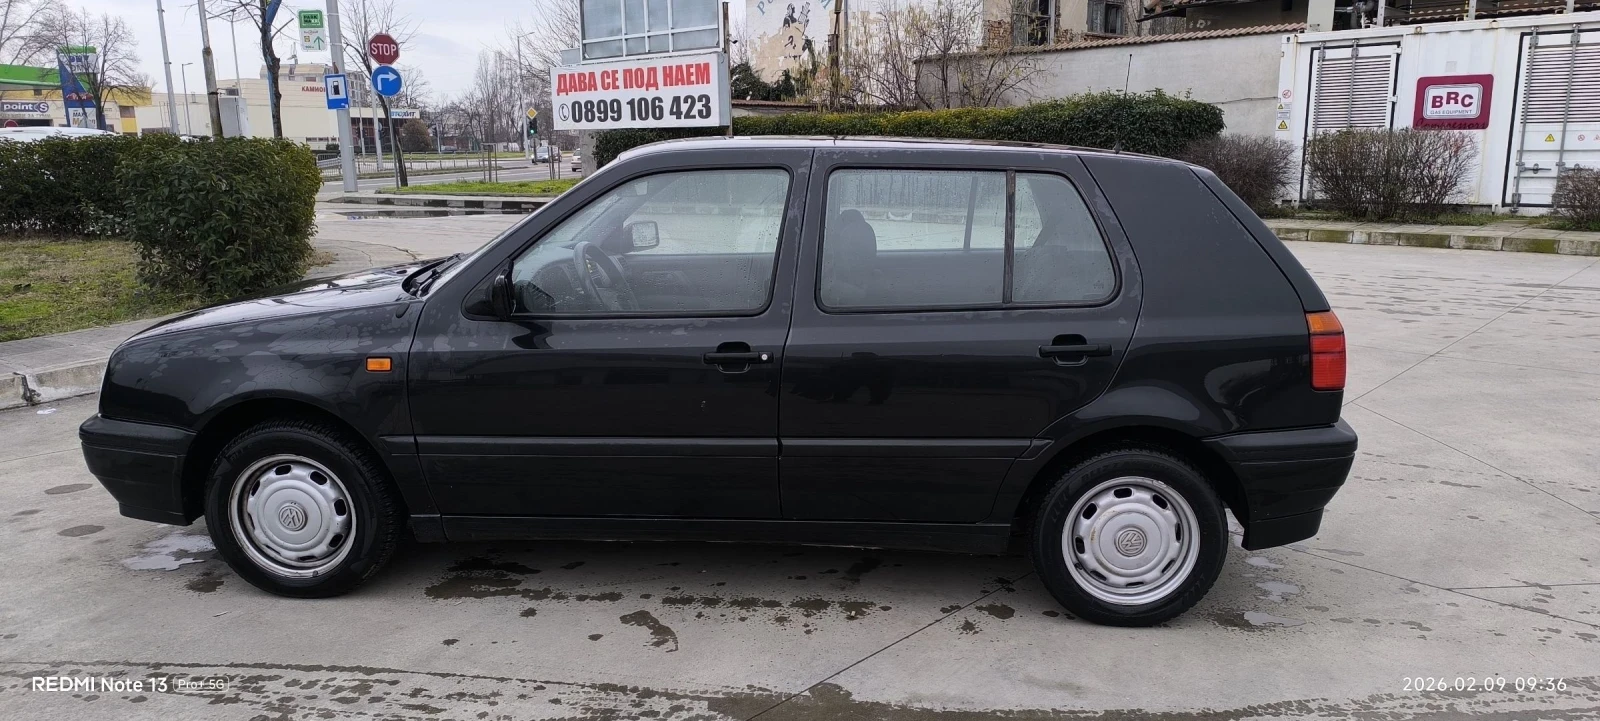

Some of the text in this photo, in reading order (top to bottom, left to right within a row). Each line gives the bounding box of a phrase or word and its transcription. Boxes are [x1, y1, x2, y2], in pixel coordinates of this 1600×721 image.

[371, 43, 397, 56] STOP
[556, 63, 710, 96] ДАВА СЕ ПОД НАЕМ
[4, 103, 48, 112] point S
[571, 94, 712, 123] 0899 106 423
[1431, 92, 1474, 109] BRC
